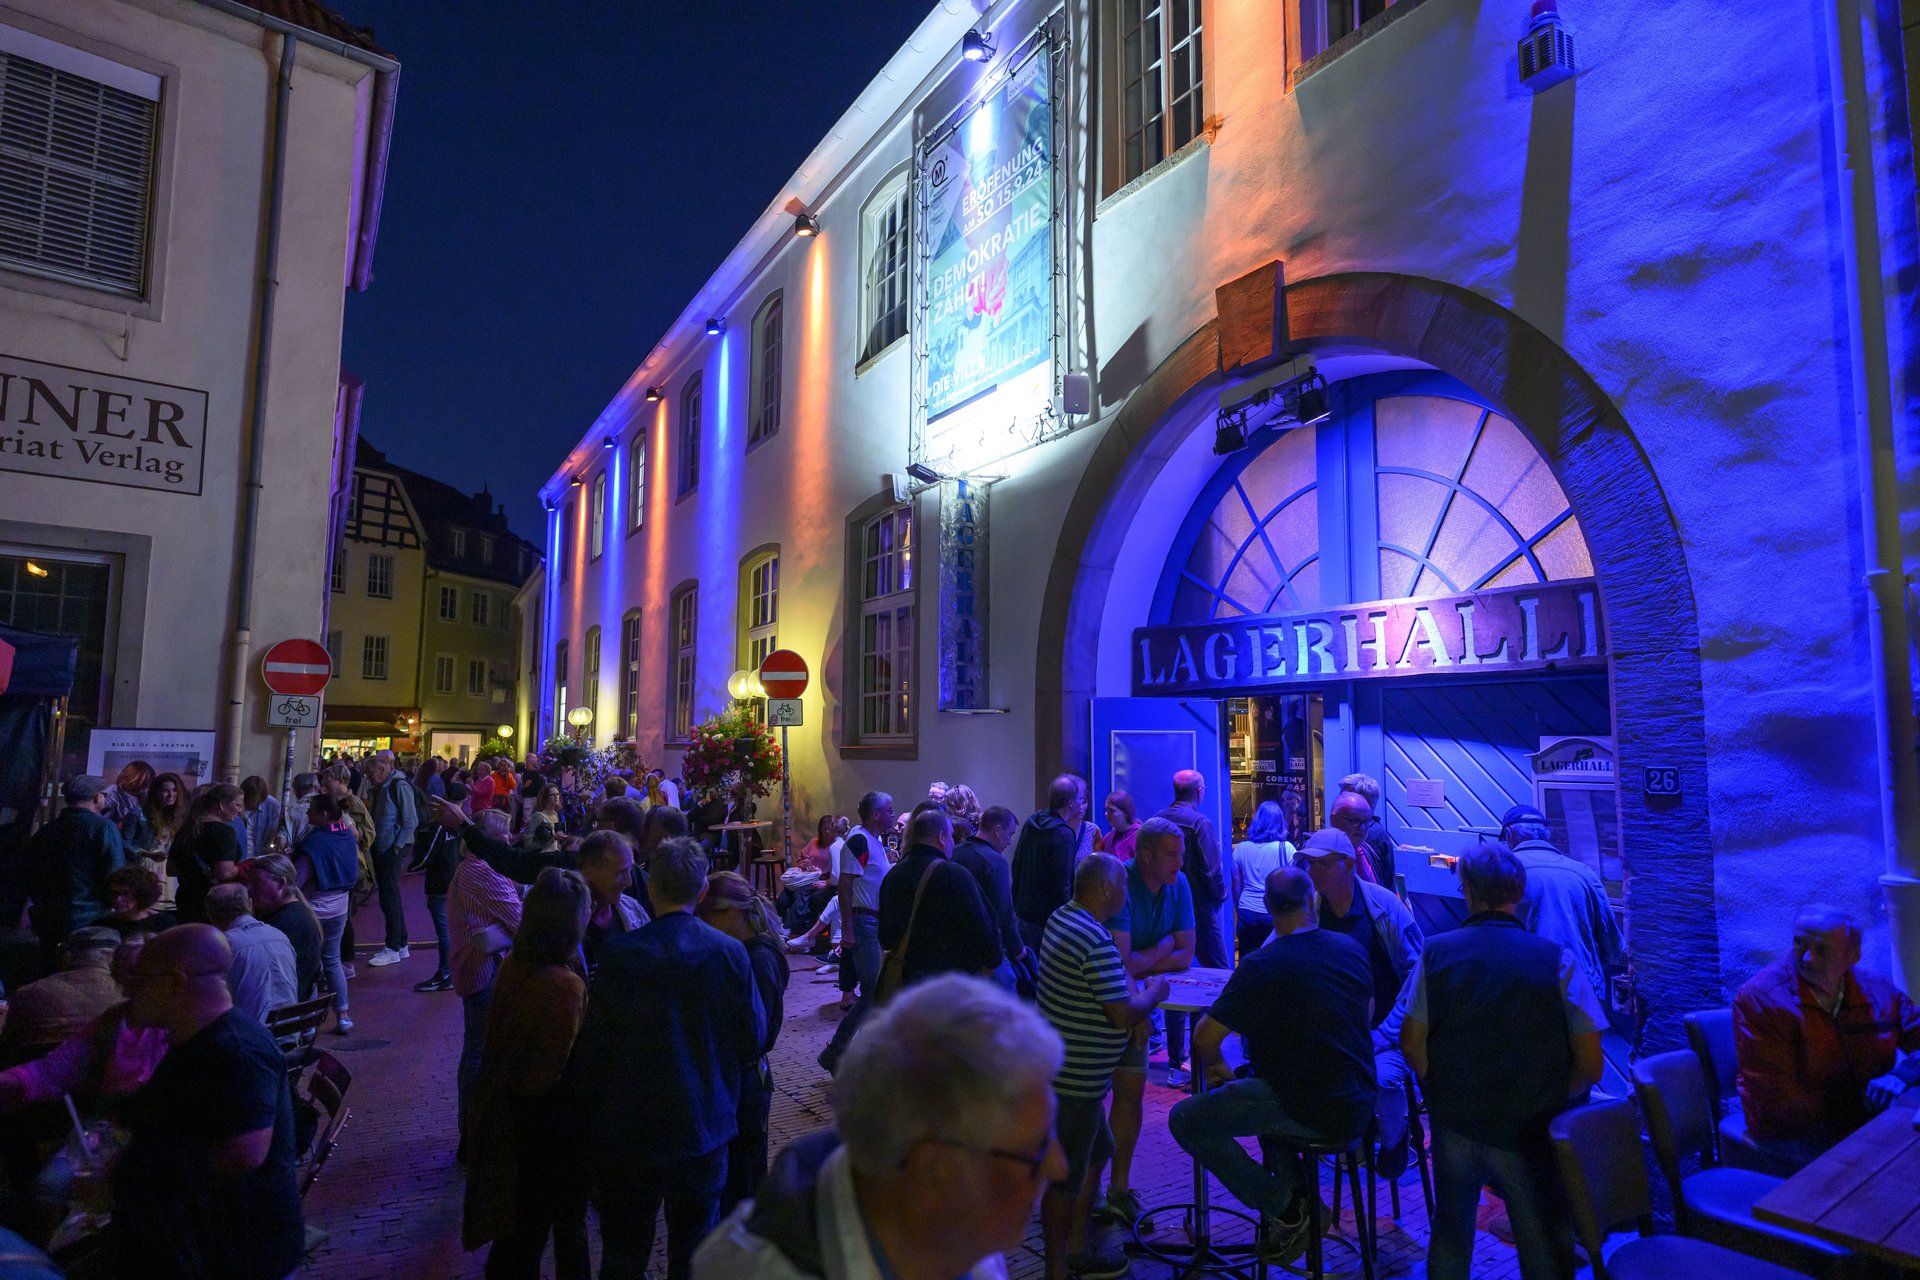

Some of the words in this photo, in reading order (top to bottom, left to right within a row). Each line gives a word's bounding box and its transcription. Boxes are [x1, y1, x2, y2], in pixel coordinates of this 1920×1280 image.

[962, 136, 1043, 213] ERÖFFNUNG
[963, 219, 975, 234] AM
[977, 198, 994, 222] SO
[997, 160, 1043, 206] 15.9.24
[933, 202, 1041, 300] DEMOKRATIE
[933, 271, 986, 325] ZÄHLT!
[932, 374, 951, 397] DIE
[72, 438, 185, 484] Verlag
[285, 715, 302, 724] frei
[1265, 775, 1304, 783] COREMY
[1650, 770, 1675, 790] 26
